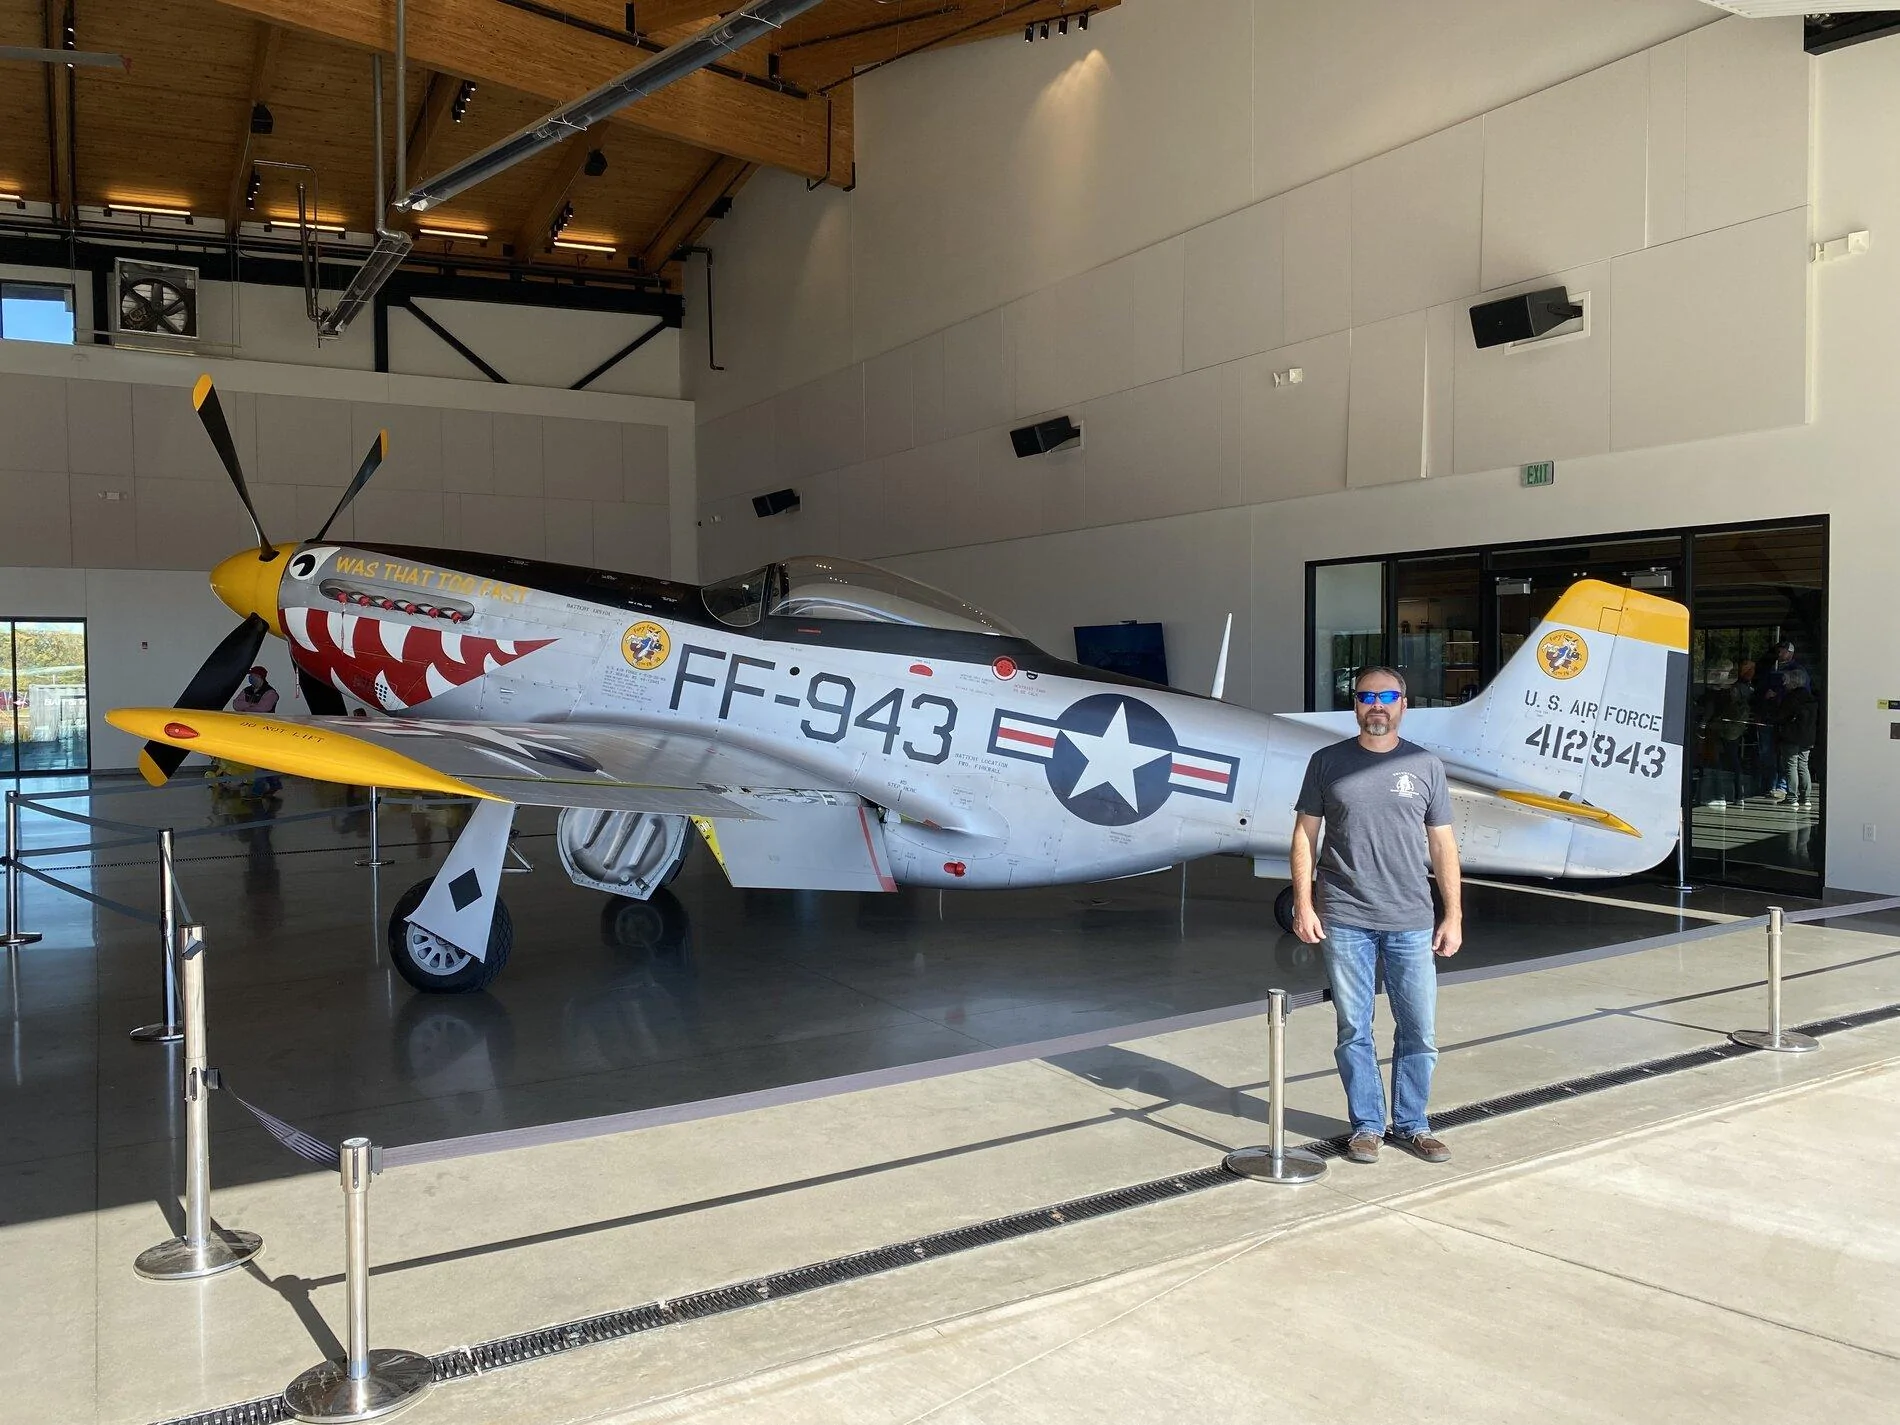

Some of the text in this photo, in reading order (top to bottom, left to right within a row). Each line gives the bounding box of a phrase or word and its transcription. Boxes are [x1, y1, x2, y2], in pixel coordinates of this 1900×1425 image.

[1527, 463, 1549, 485] EXIT
[335, 555, 530, 604] WAS THAT TOO FAST
[669, 643, 959, 765] FF-943
[1570, 699, 1599, 720] AIR
[1604, 705, 1662, 732] FORCE
[262, 725, 286, 734] NOT
[292, 731, 325, 743] LIFT
[981, 757, 1009, 768] LOCATION
[1525, 723, 1667, 779] 412943
